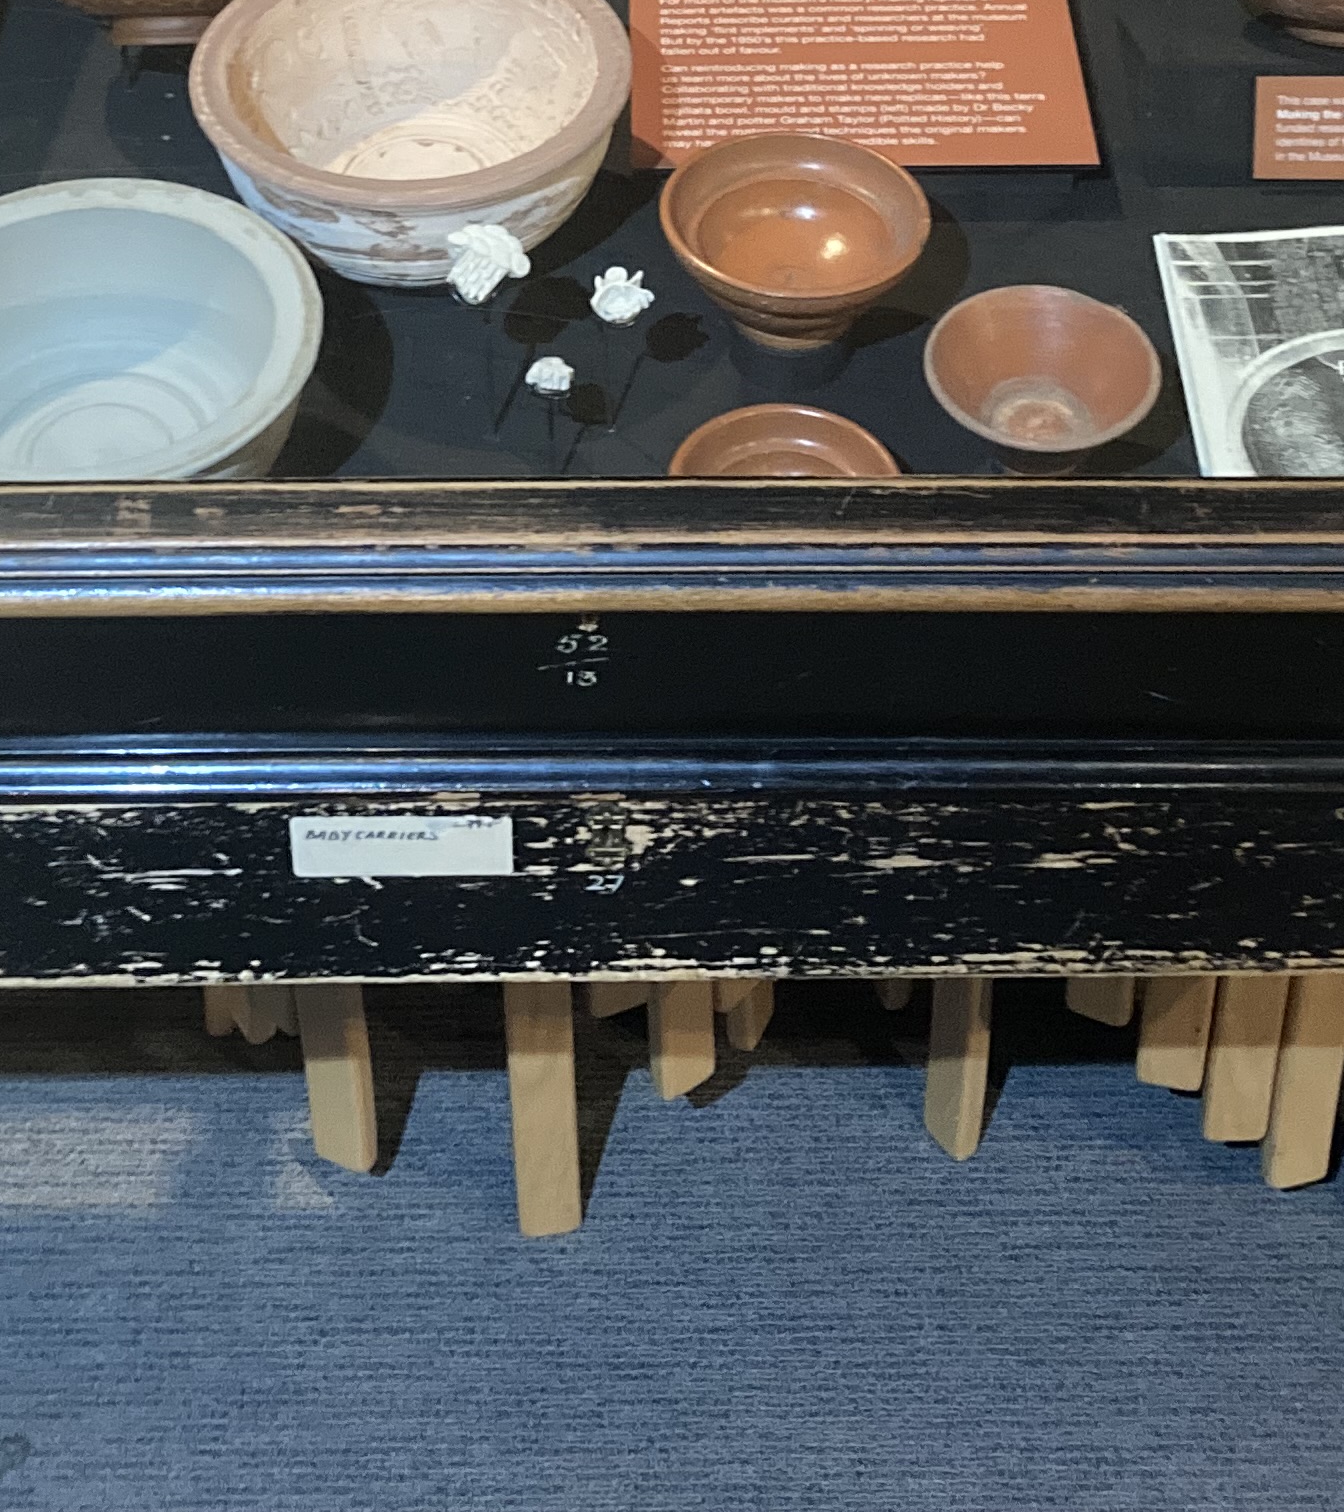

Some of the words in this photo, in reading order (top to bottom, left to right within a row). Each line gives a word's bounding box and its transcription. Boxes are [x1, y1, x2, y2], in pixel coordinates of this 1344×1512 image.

[556, 634, 608, 654] 52
[566, 671, 598, 687] 13
[584, 874, 625, 895] 27
